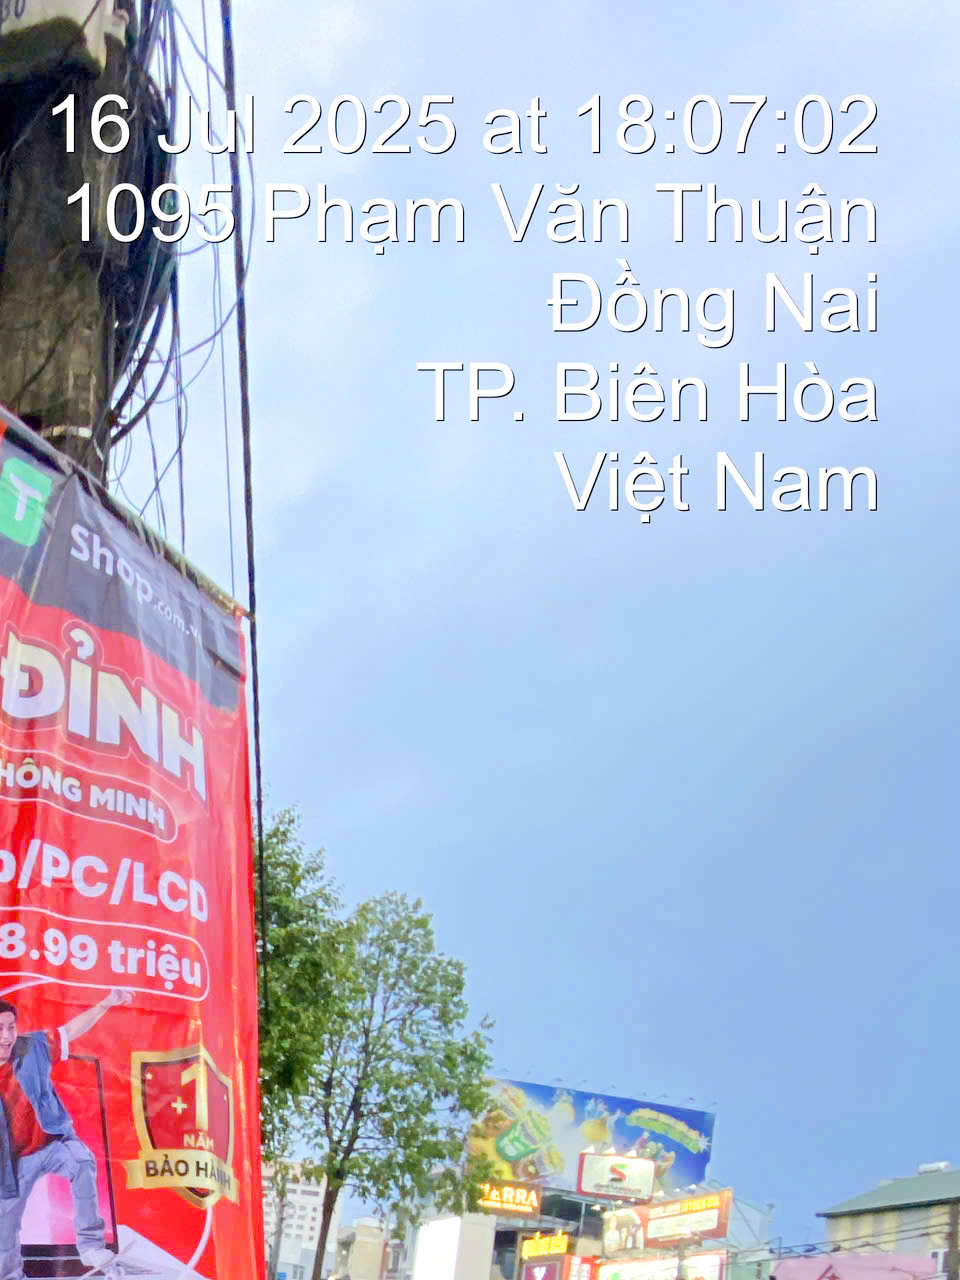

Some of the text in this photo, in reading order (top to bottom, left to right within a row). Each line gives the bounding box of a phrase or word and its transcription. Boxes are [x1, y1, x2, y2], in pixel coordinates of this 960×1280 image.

[0, 625, 207, 802] ĐỈNH
[90, 785, 166, 832] MINH
[109, 936, 202, 990] triệu
[145, 1154, 189, 1177] BẢO
